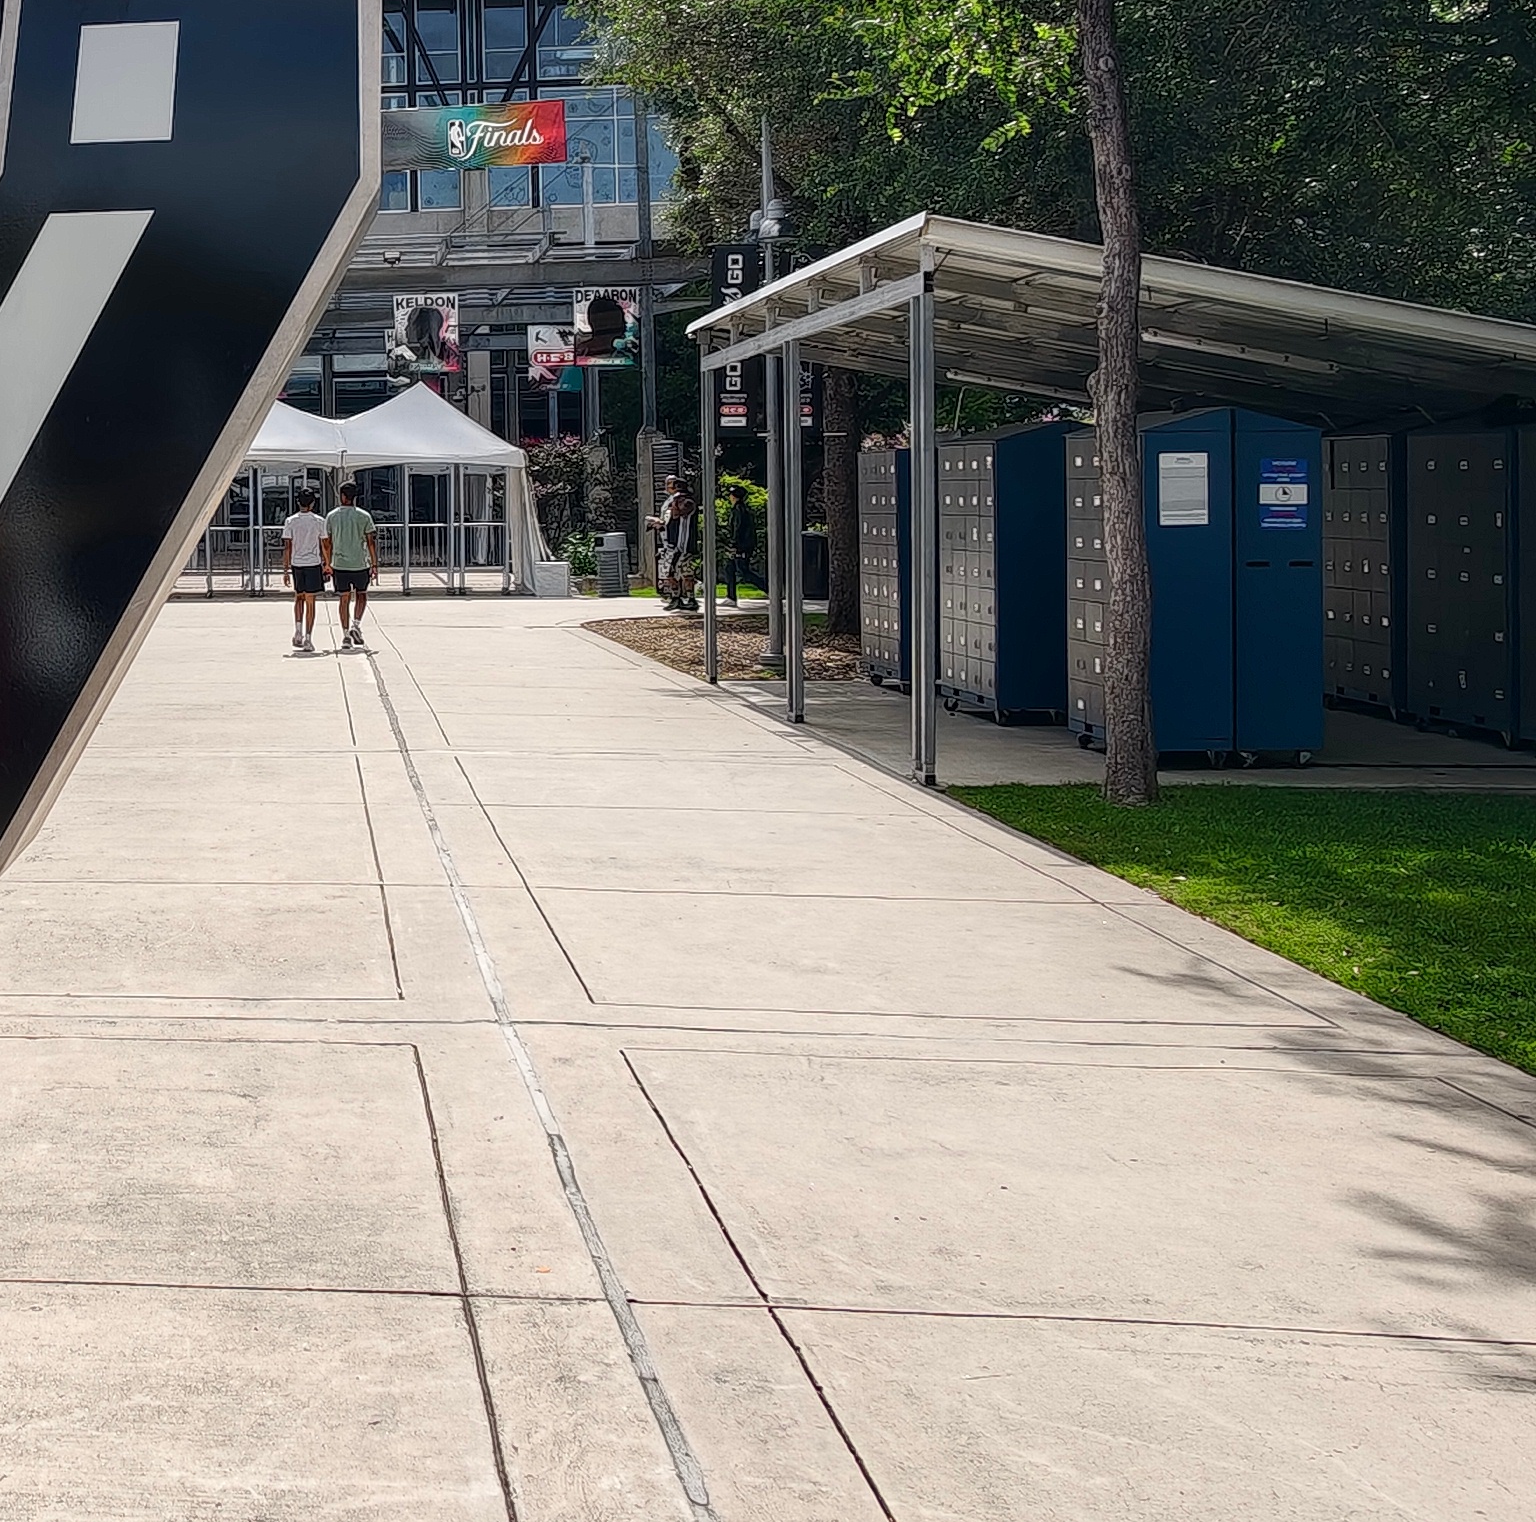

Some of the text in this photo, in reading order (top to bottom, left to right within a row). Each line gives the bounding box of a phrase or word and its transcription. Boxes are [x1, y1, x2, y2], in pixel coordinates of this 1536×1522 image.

[459, 118, 545, 160] Finals
[727, 253, 744, 285] GO
[395, 295, 456, 310] KELDON
